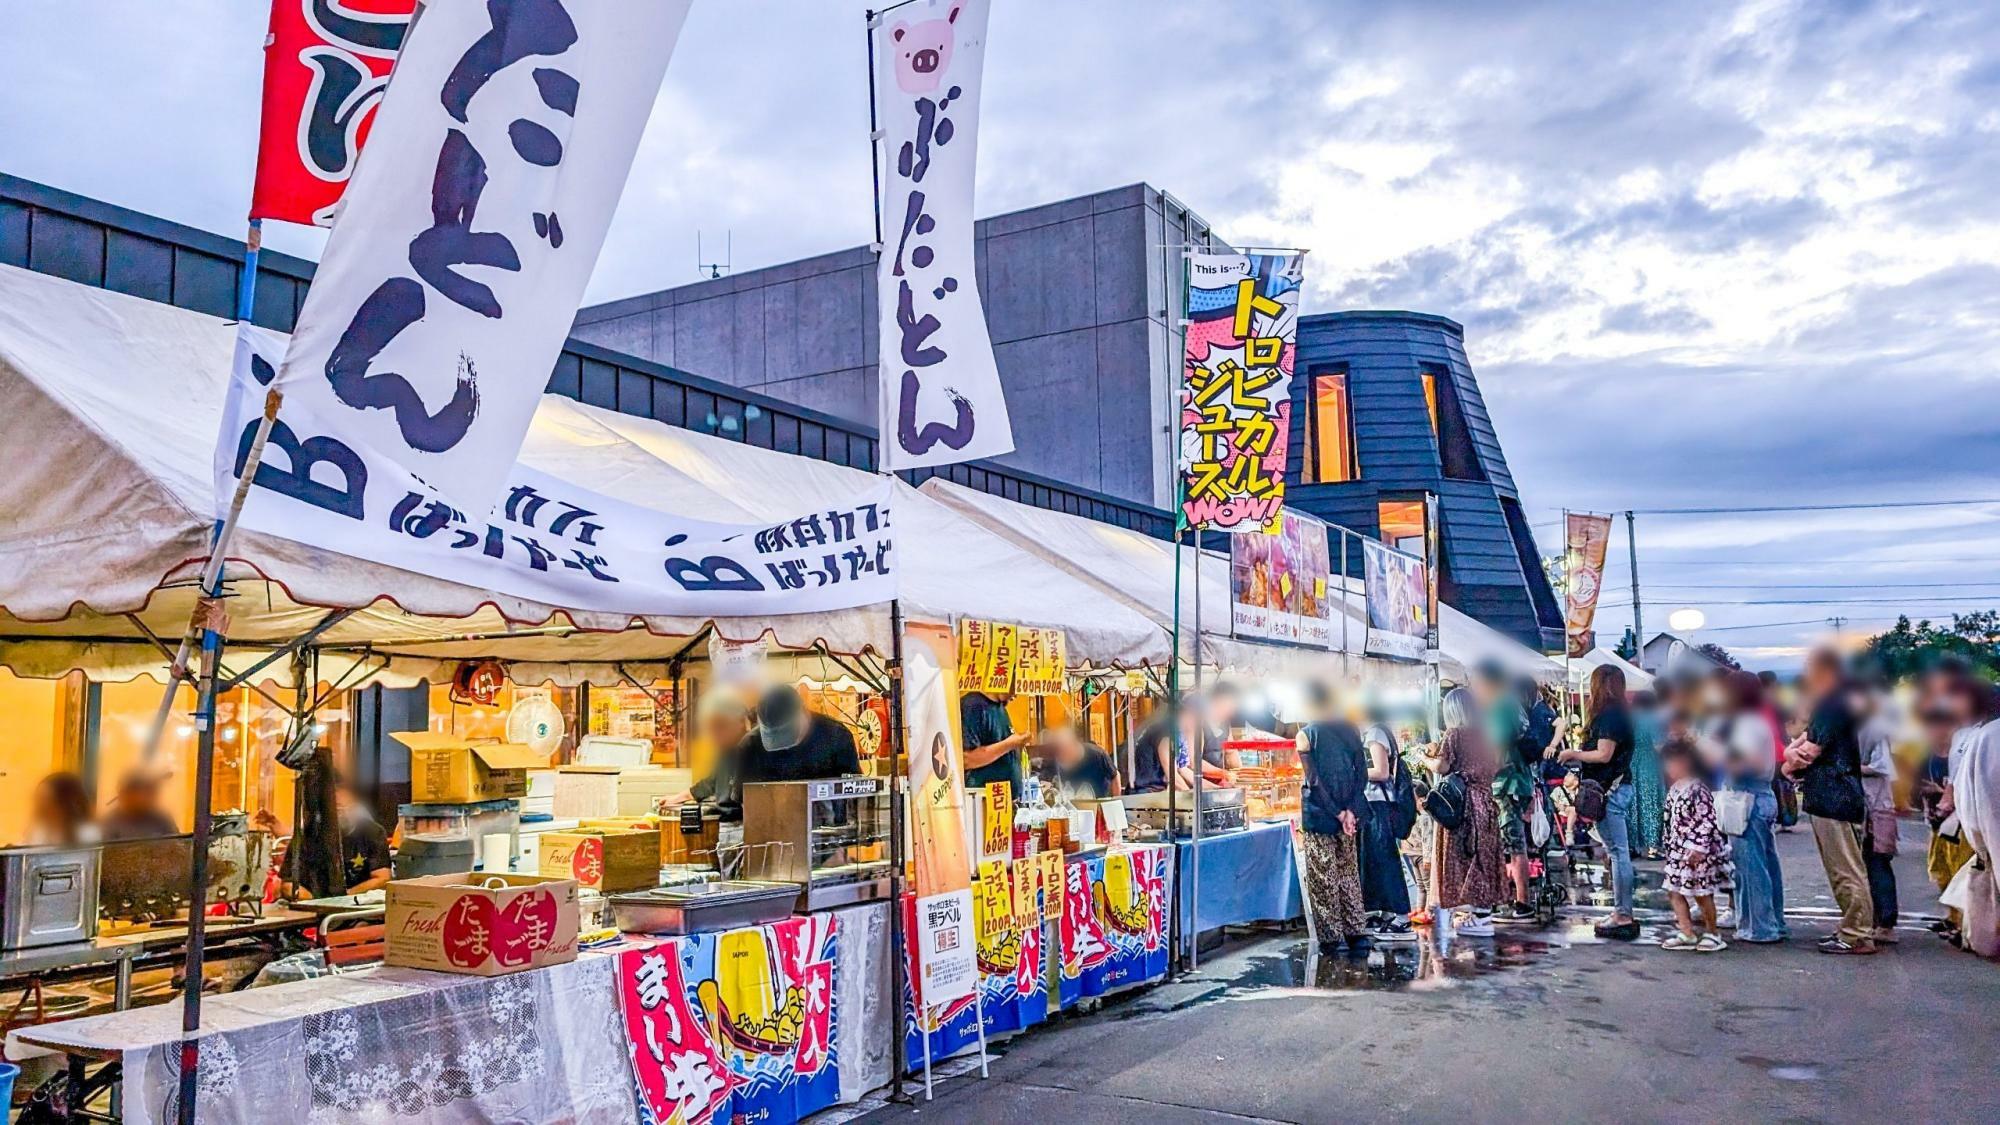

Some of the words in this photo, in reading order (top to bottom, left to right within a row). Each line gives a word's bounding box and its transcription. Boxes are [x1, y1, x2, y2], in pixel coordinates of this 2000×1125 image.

[1194, 263, 1218, 275] This
[1227, 278, 1283, 496] トロピカル
[1188, 358, 1236, 502] ジュース
[1182, 495, 1284, 528] WOW!
[966, 620, 983, 676] 生ビール
[993, 626, 1011, 677] ウーロン茶
[1019, 639, 1030, 679] コーヒー
[1029, 628, 1039, 659] アイス
[958, 676, 982, 690] 600円
[988, 677, 1008, 689] 200円
[1016, 679, 1041, 693] 200円
[991, 783, 1005, 837] 生ビール
[985, 837, 1009, 854] 600円
[992, 859, 1006, 893] アイス
[1020, 859, 1031, 913] アイスティー
[1046, 853, 1061, 904] ウーロン茶
[984, 874, 998, 918] コーヒー
[1044, 902, 1062, 918] 200円
[401, 910, 447, 934] Fresh
[452, 894, 490, 967] たまご
[503, 893, 549, 967] たまご
[928, 907, 962, 927] 黒ラベル
[985, 914, 1011, 935] 200円
[1016, 911, 1039, 930] 200円
